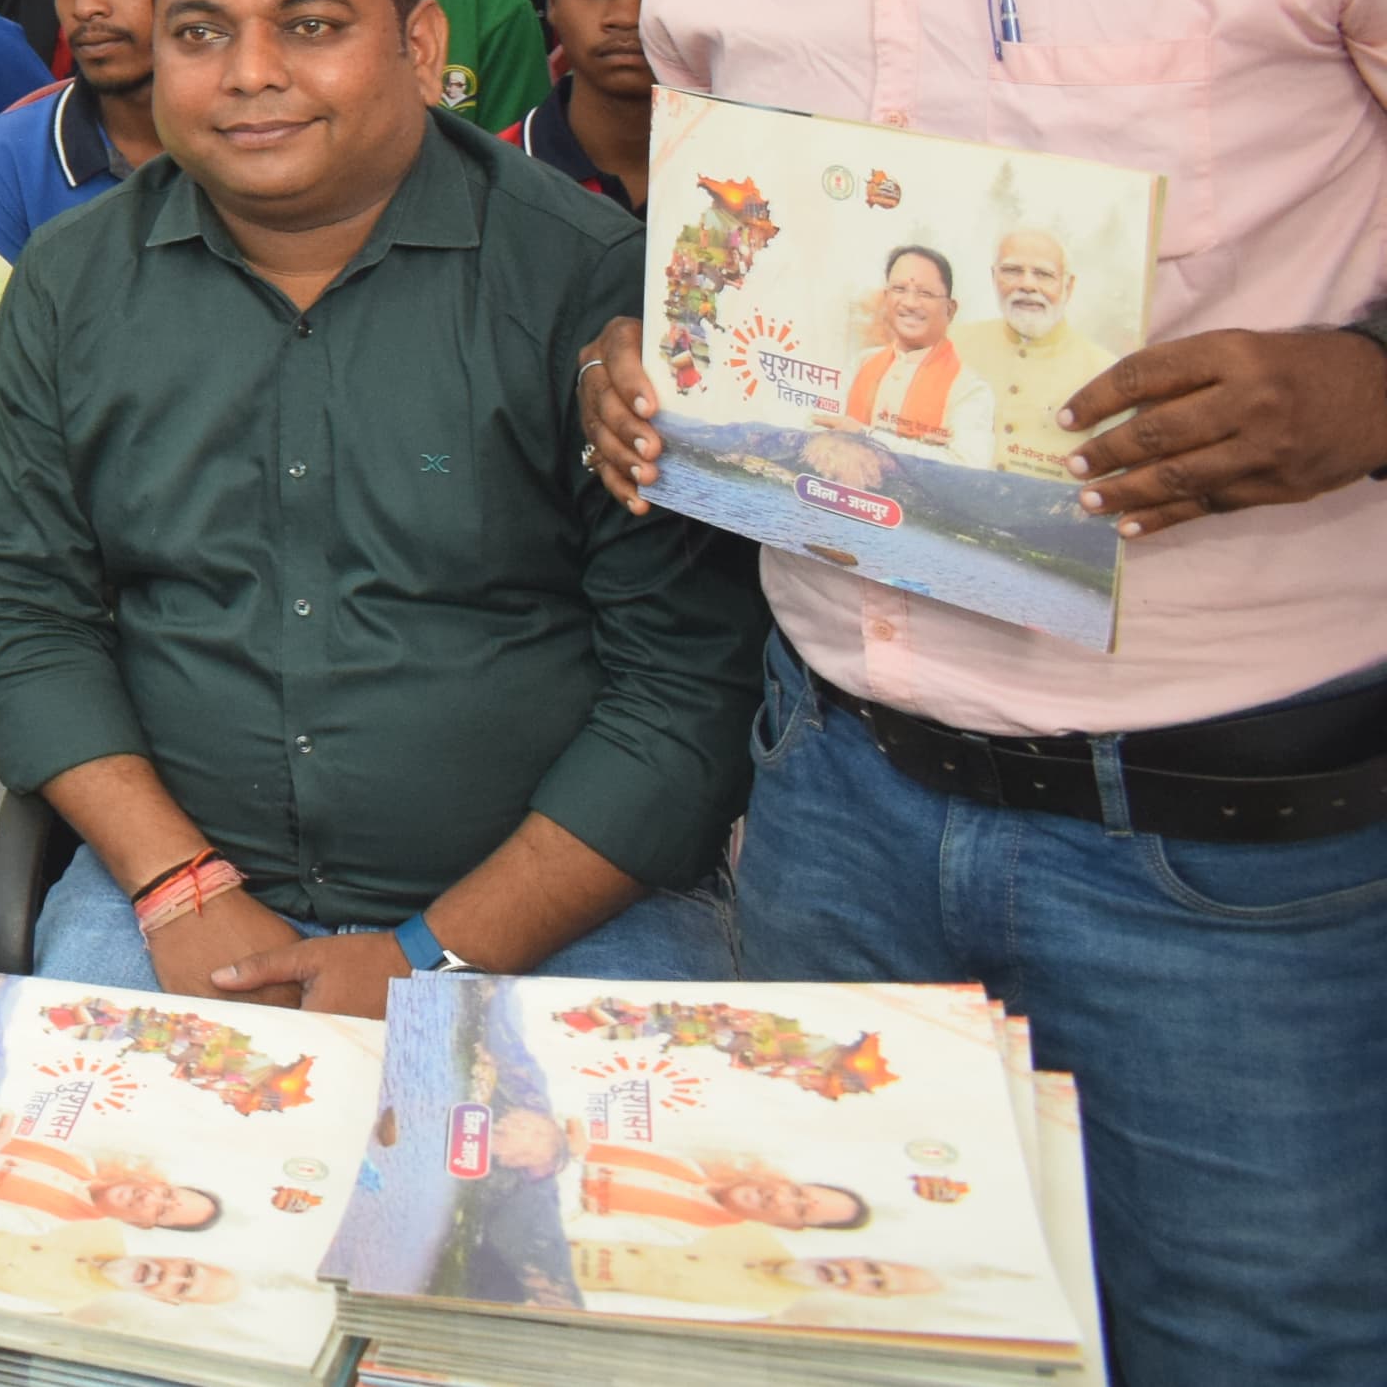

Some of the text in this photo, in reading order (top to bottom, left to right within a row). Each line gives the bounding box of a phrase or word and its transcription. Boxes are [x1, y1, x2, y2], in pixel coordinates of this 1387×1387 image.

[757, 350, 841, 391] सुशासन
[776, 380, 817, 408] तिहार
[806, 479, 838, 505] जिला
[847, 495, 889, 521] जशपुर
